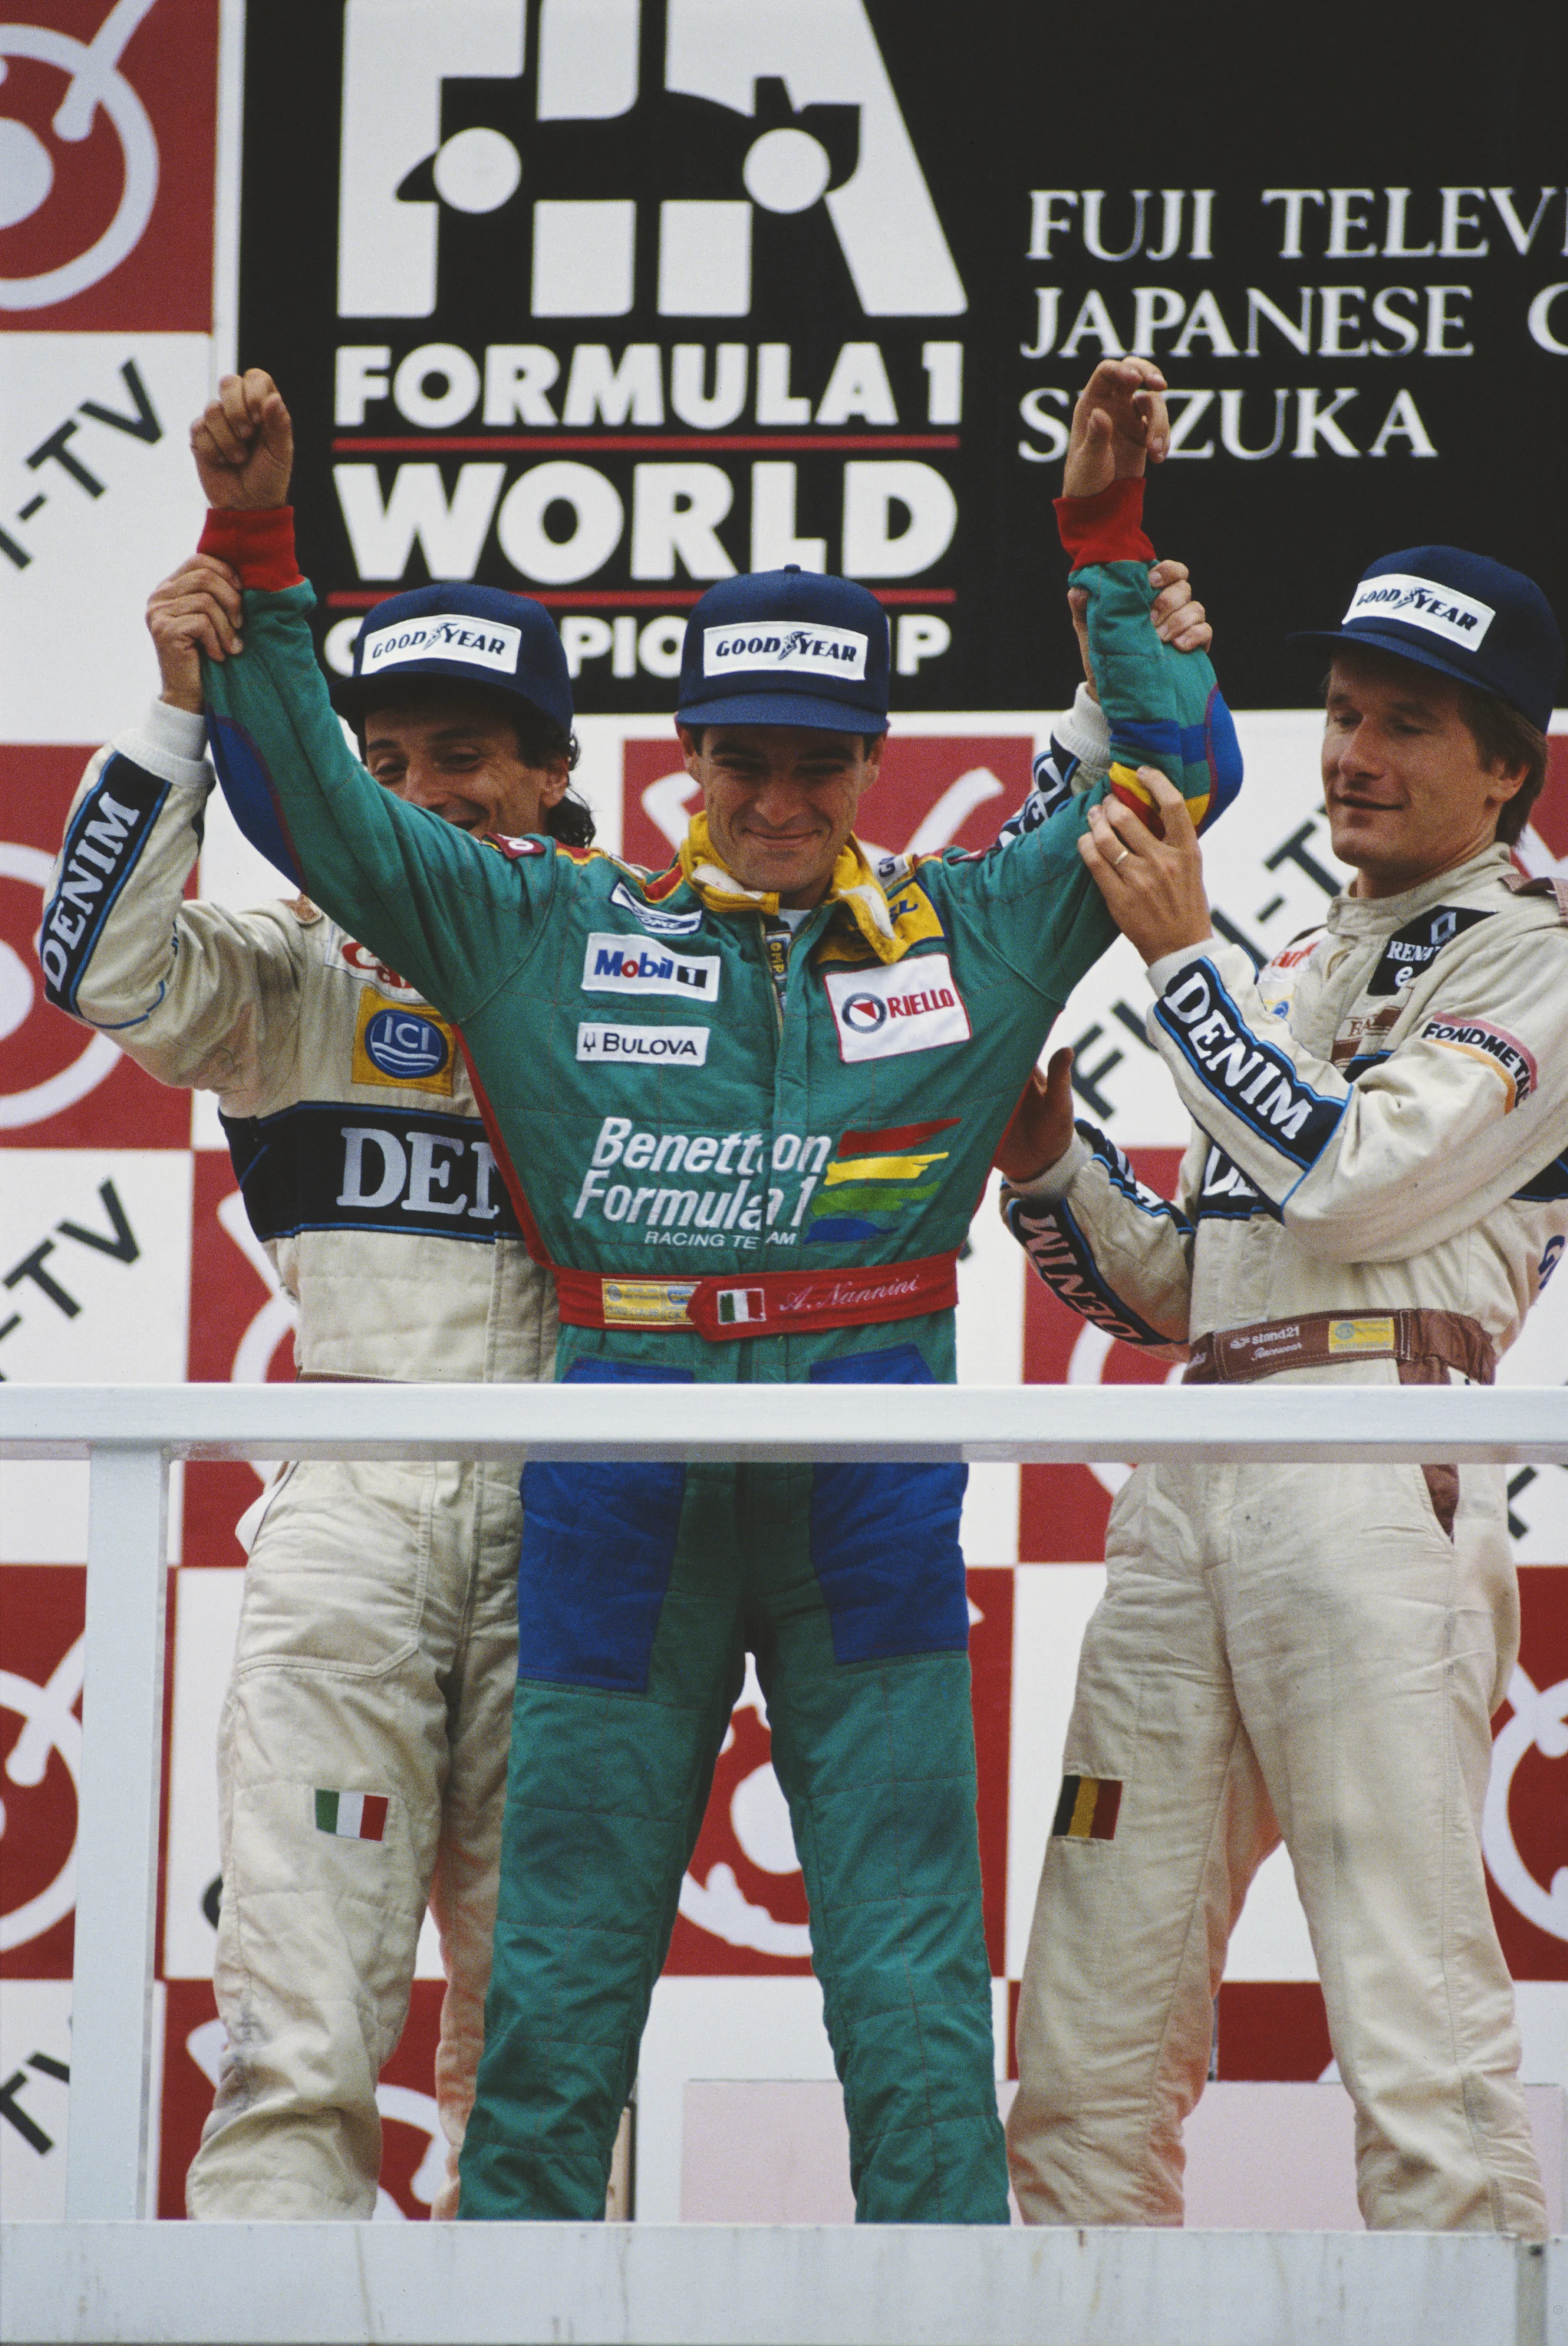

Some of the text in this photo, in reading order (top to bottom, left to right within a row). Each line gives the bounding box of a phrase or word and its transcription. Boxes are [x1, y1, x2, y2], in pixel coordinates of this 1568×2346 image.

[1026, 186, 1568, 262] FUJI TELEV
[1020, 285, 1474, 359] JAPANESE
[334, 342, 963, 429] FORMULA 1
[1018, 387, 1439, 463] SZUKA
[332, 459, 958, 585] WORLD
[42, 792, 140, 991] DENIM
[594, 949, 674, 980] Mobil
[770, 941, 785, 973] OMP
[384, 1015, 430, 1052] ICI
[886, 988, 955, 1018] RIELLO
[602, 1032, 698, 1057] BULOVA
[1163, 971, 1313, 1141] DENIM
[591, 1116, 832, 1175] Benetton
[572, 1169, 819, 1232] Formula 1
[644, 1230, 798, 1250] RACING TEAM
[816, 1273, 921, 1306] Nannini
[1019, 1212, 1145, 1340] DENIM
